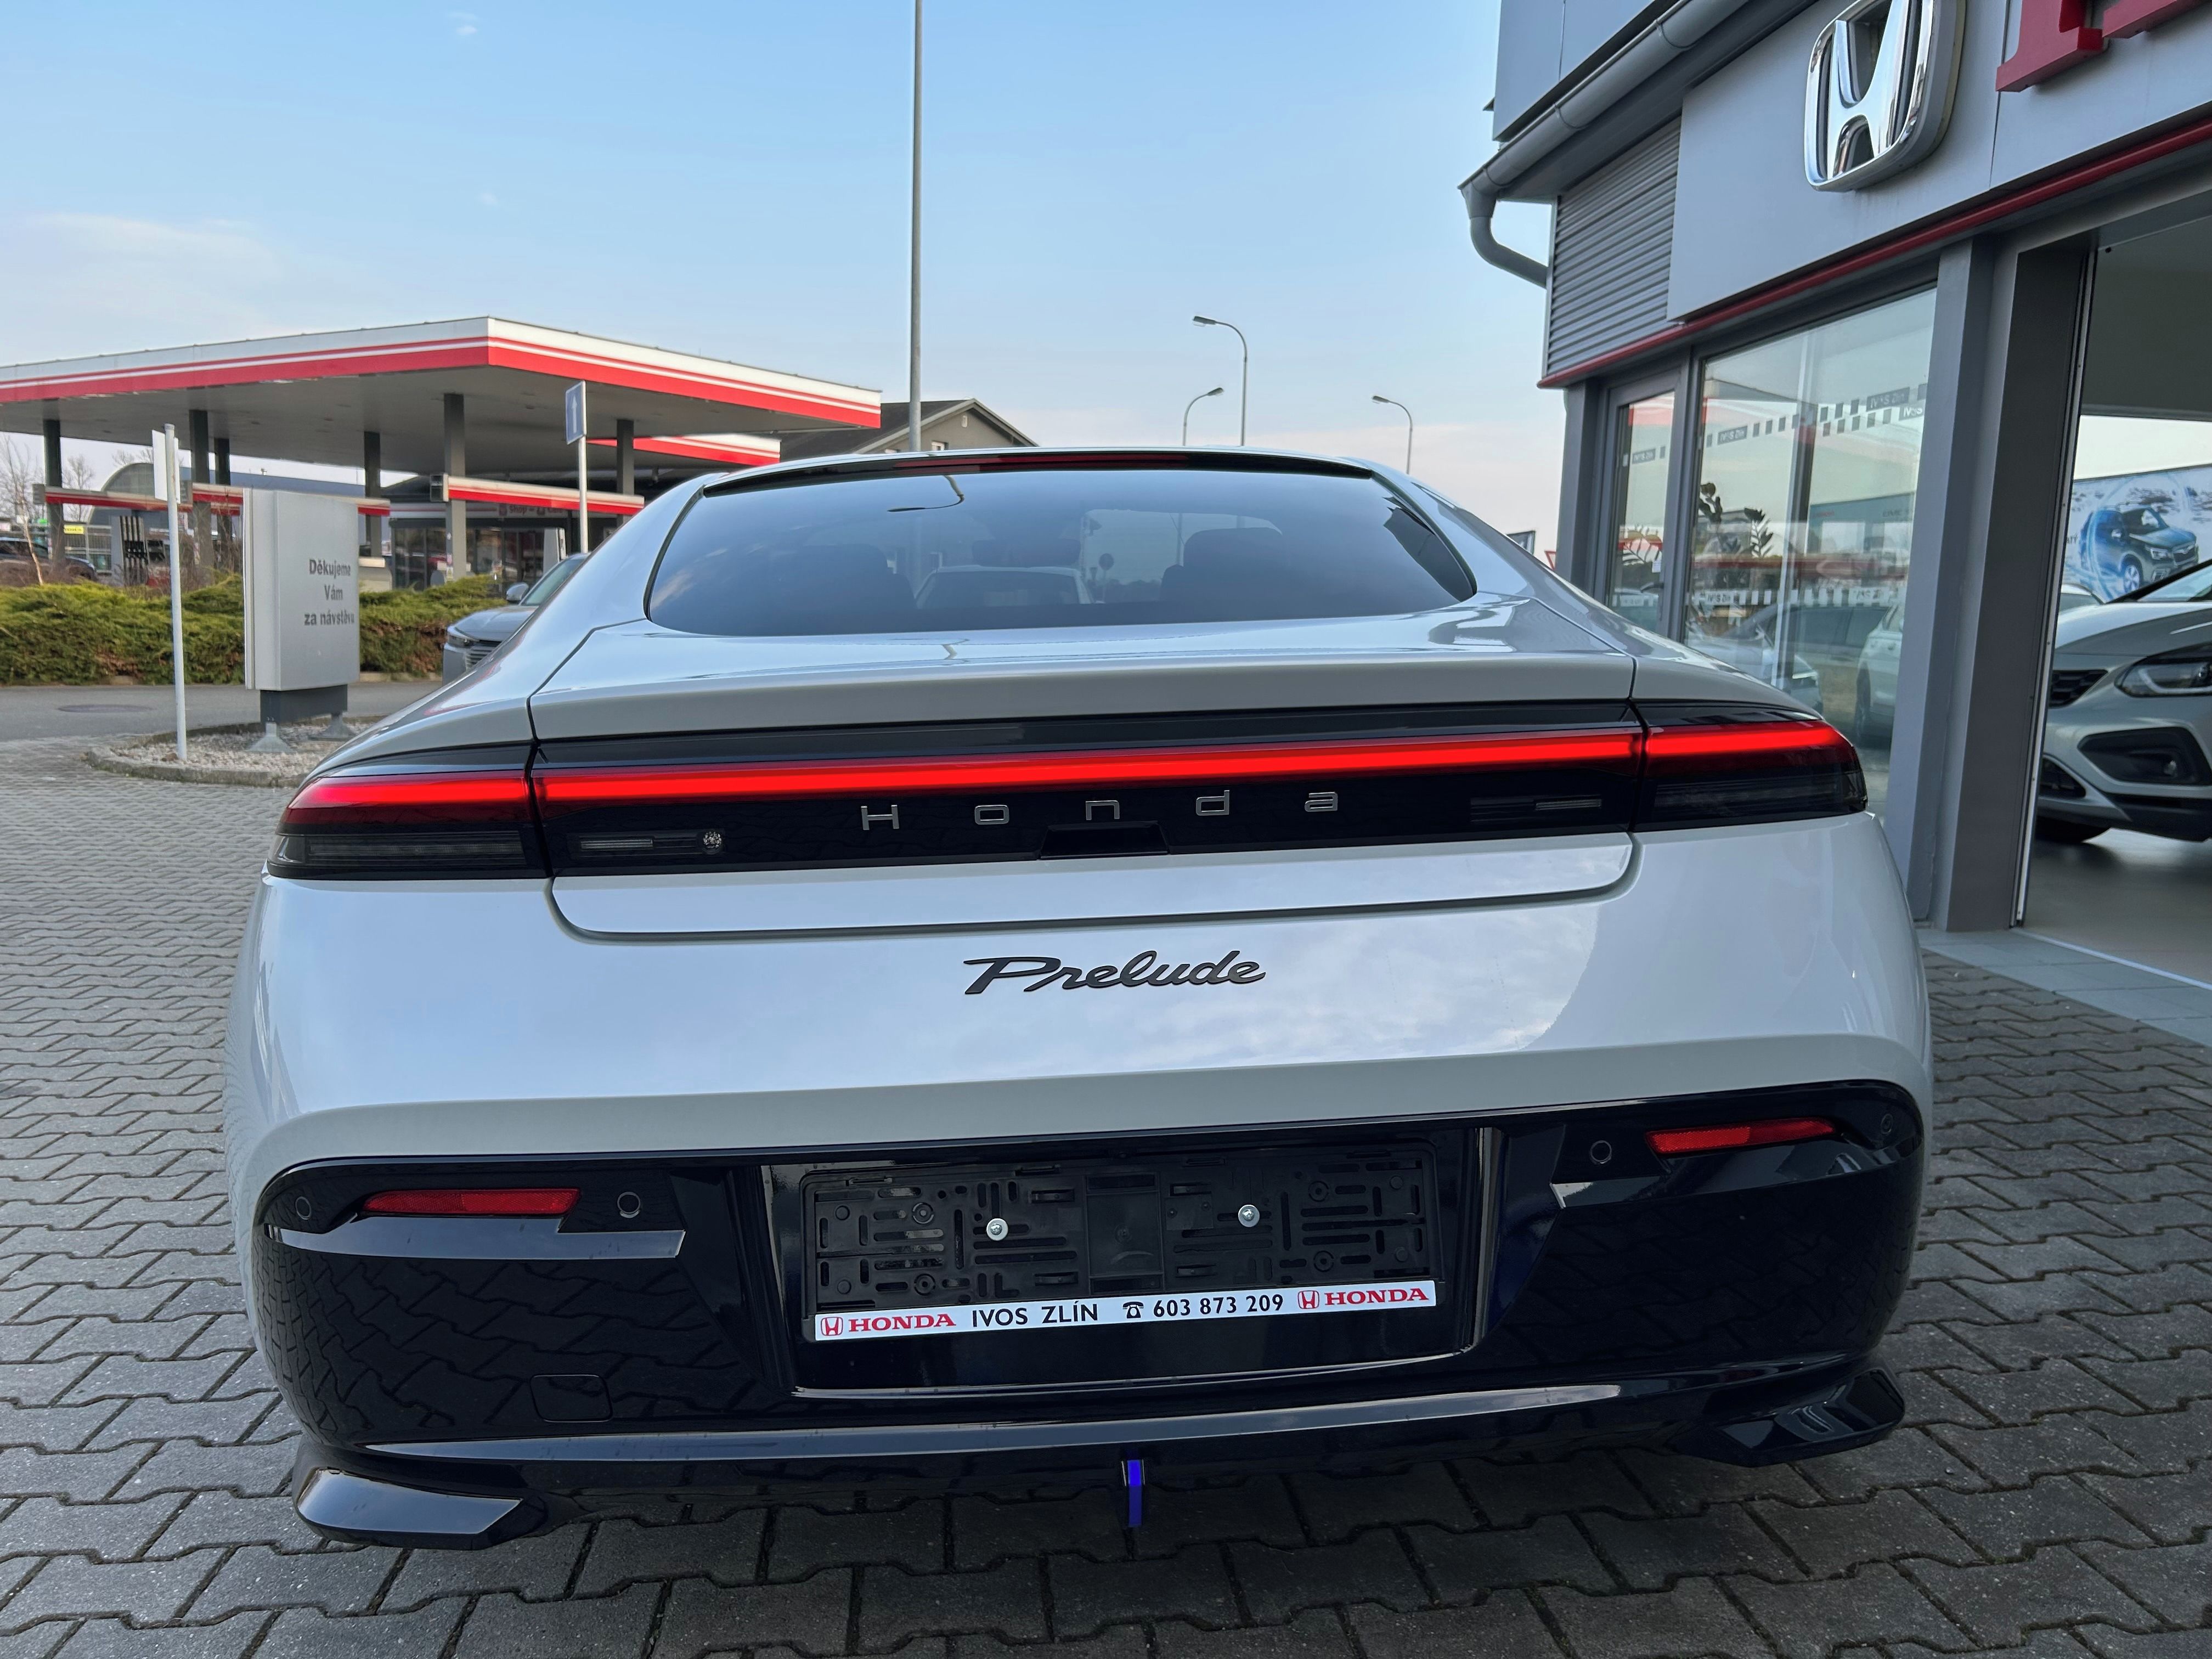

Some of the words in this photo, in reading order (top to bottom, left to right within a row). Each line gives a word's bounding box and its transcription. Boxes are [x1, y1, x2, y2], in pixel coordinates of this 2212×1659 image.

[309, 558, 351, 579] Děkujeme
[324, 584, 343, 601] Vám
[304, 613, 317, 625] za
[861, 790, 1339, 831] Honda
[963, 951, 1266, 995] Prelude
[848, 1313, 956, 1332] HONDA
[972, 1307, 1028, 1328] IVOS
[1041, 1300, 1098, 1324] ZLÍN
[1153, 1299, 1190, 1317] 603
[1200, 1296, 1237, 1314] 873
[1246, 1294, 1284, 1312] 209
[1324, 1288, 1429, 1306] HONDA
